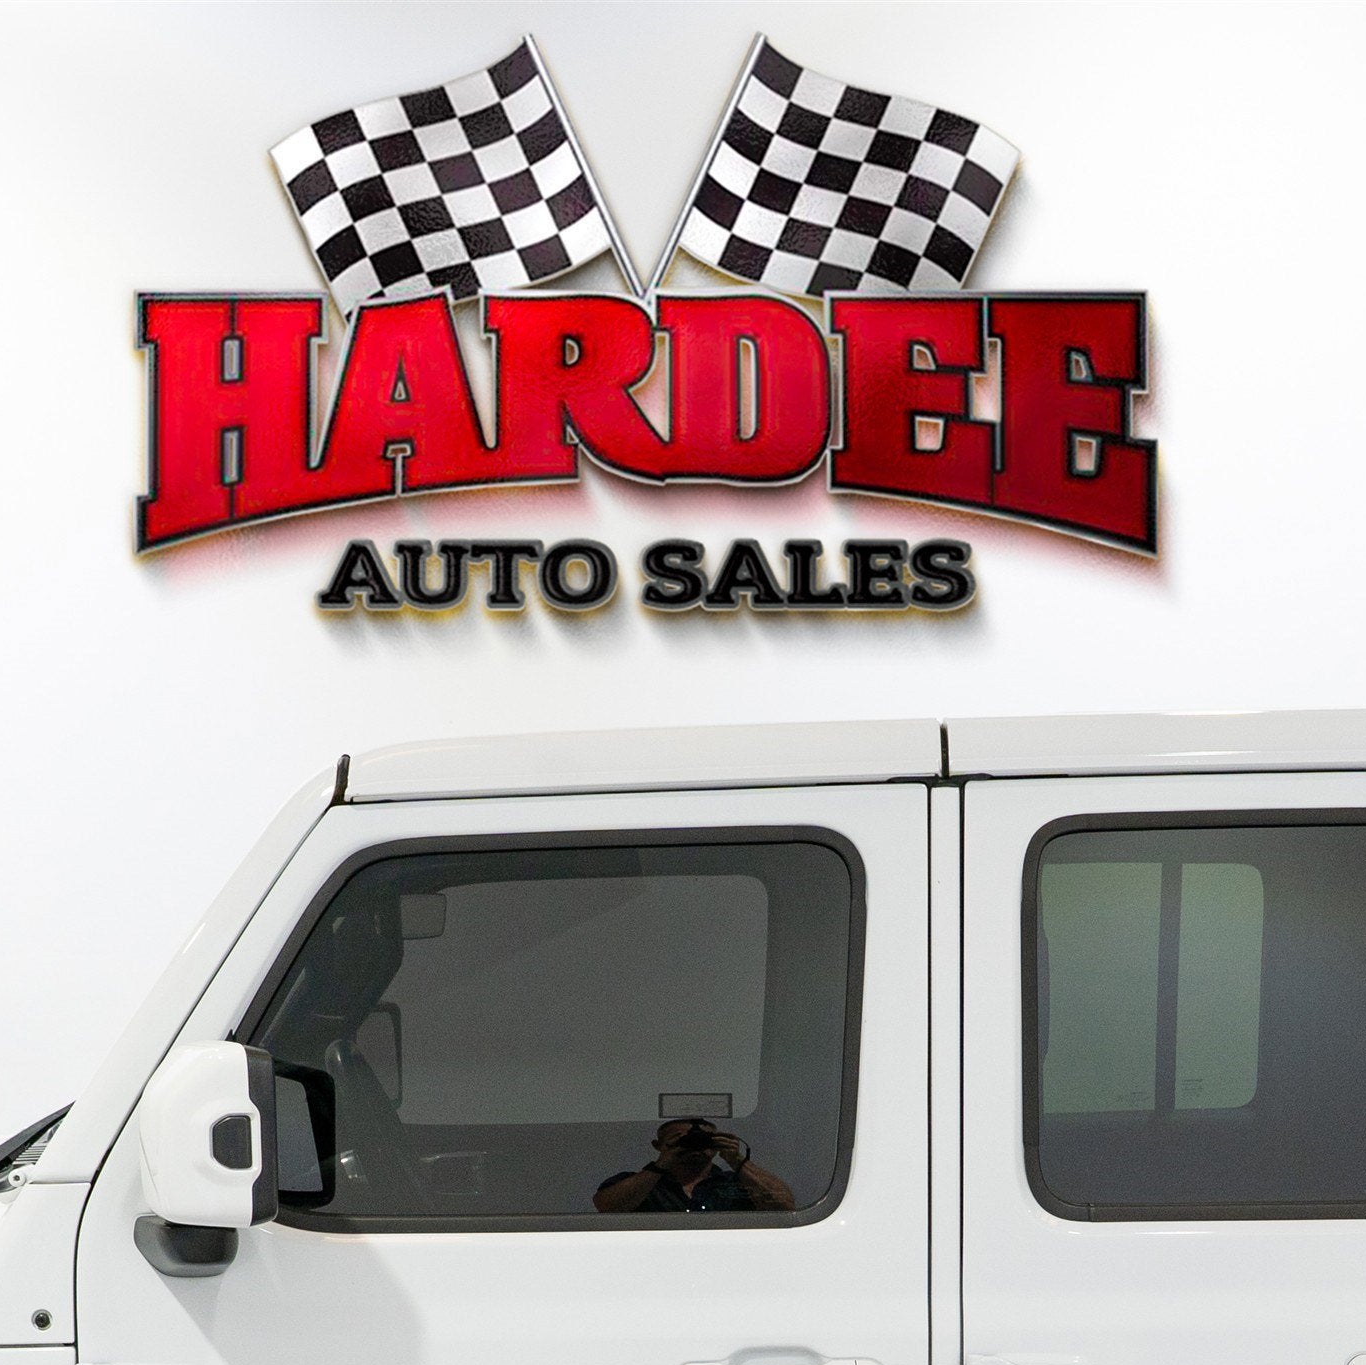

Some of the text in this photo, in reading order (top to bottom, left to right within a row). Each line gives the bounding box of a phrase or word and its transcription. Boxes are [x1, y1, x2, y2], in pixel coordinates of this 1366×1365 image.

[135, 290, 1159, 553] HARDEE
[320, 538, 978, 610] AUTO SALES
